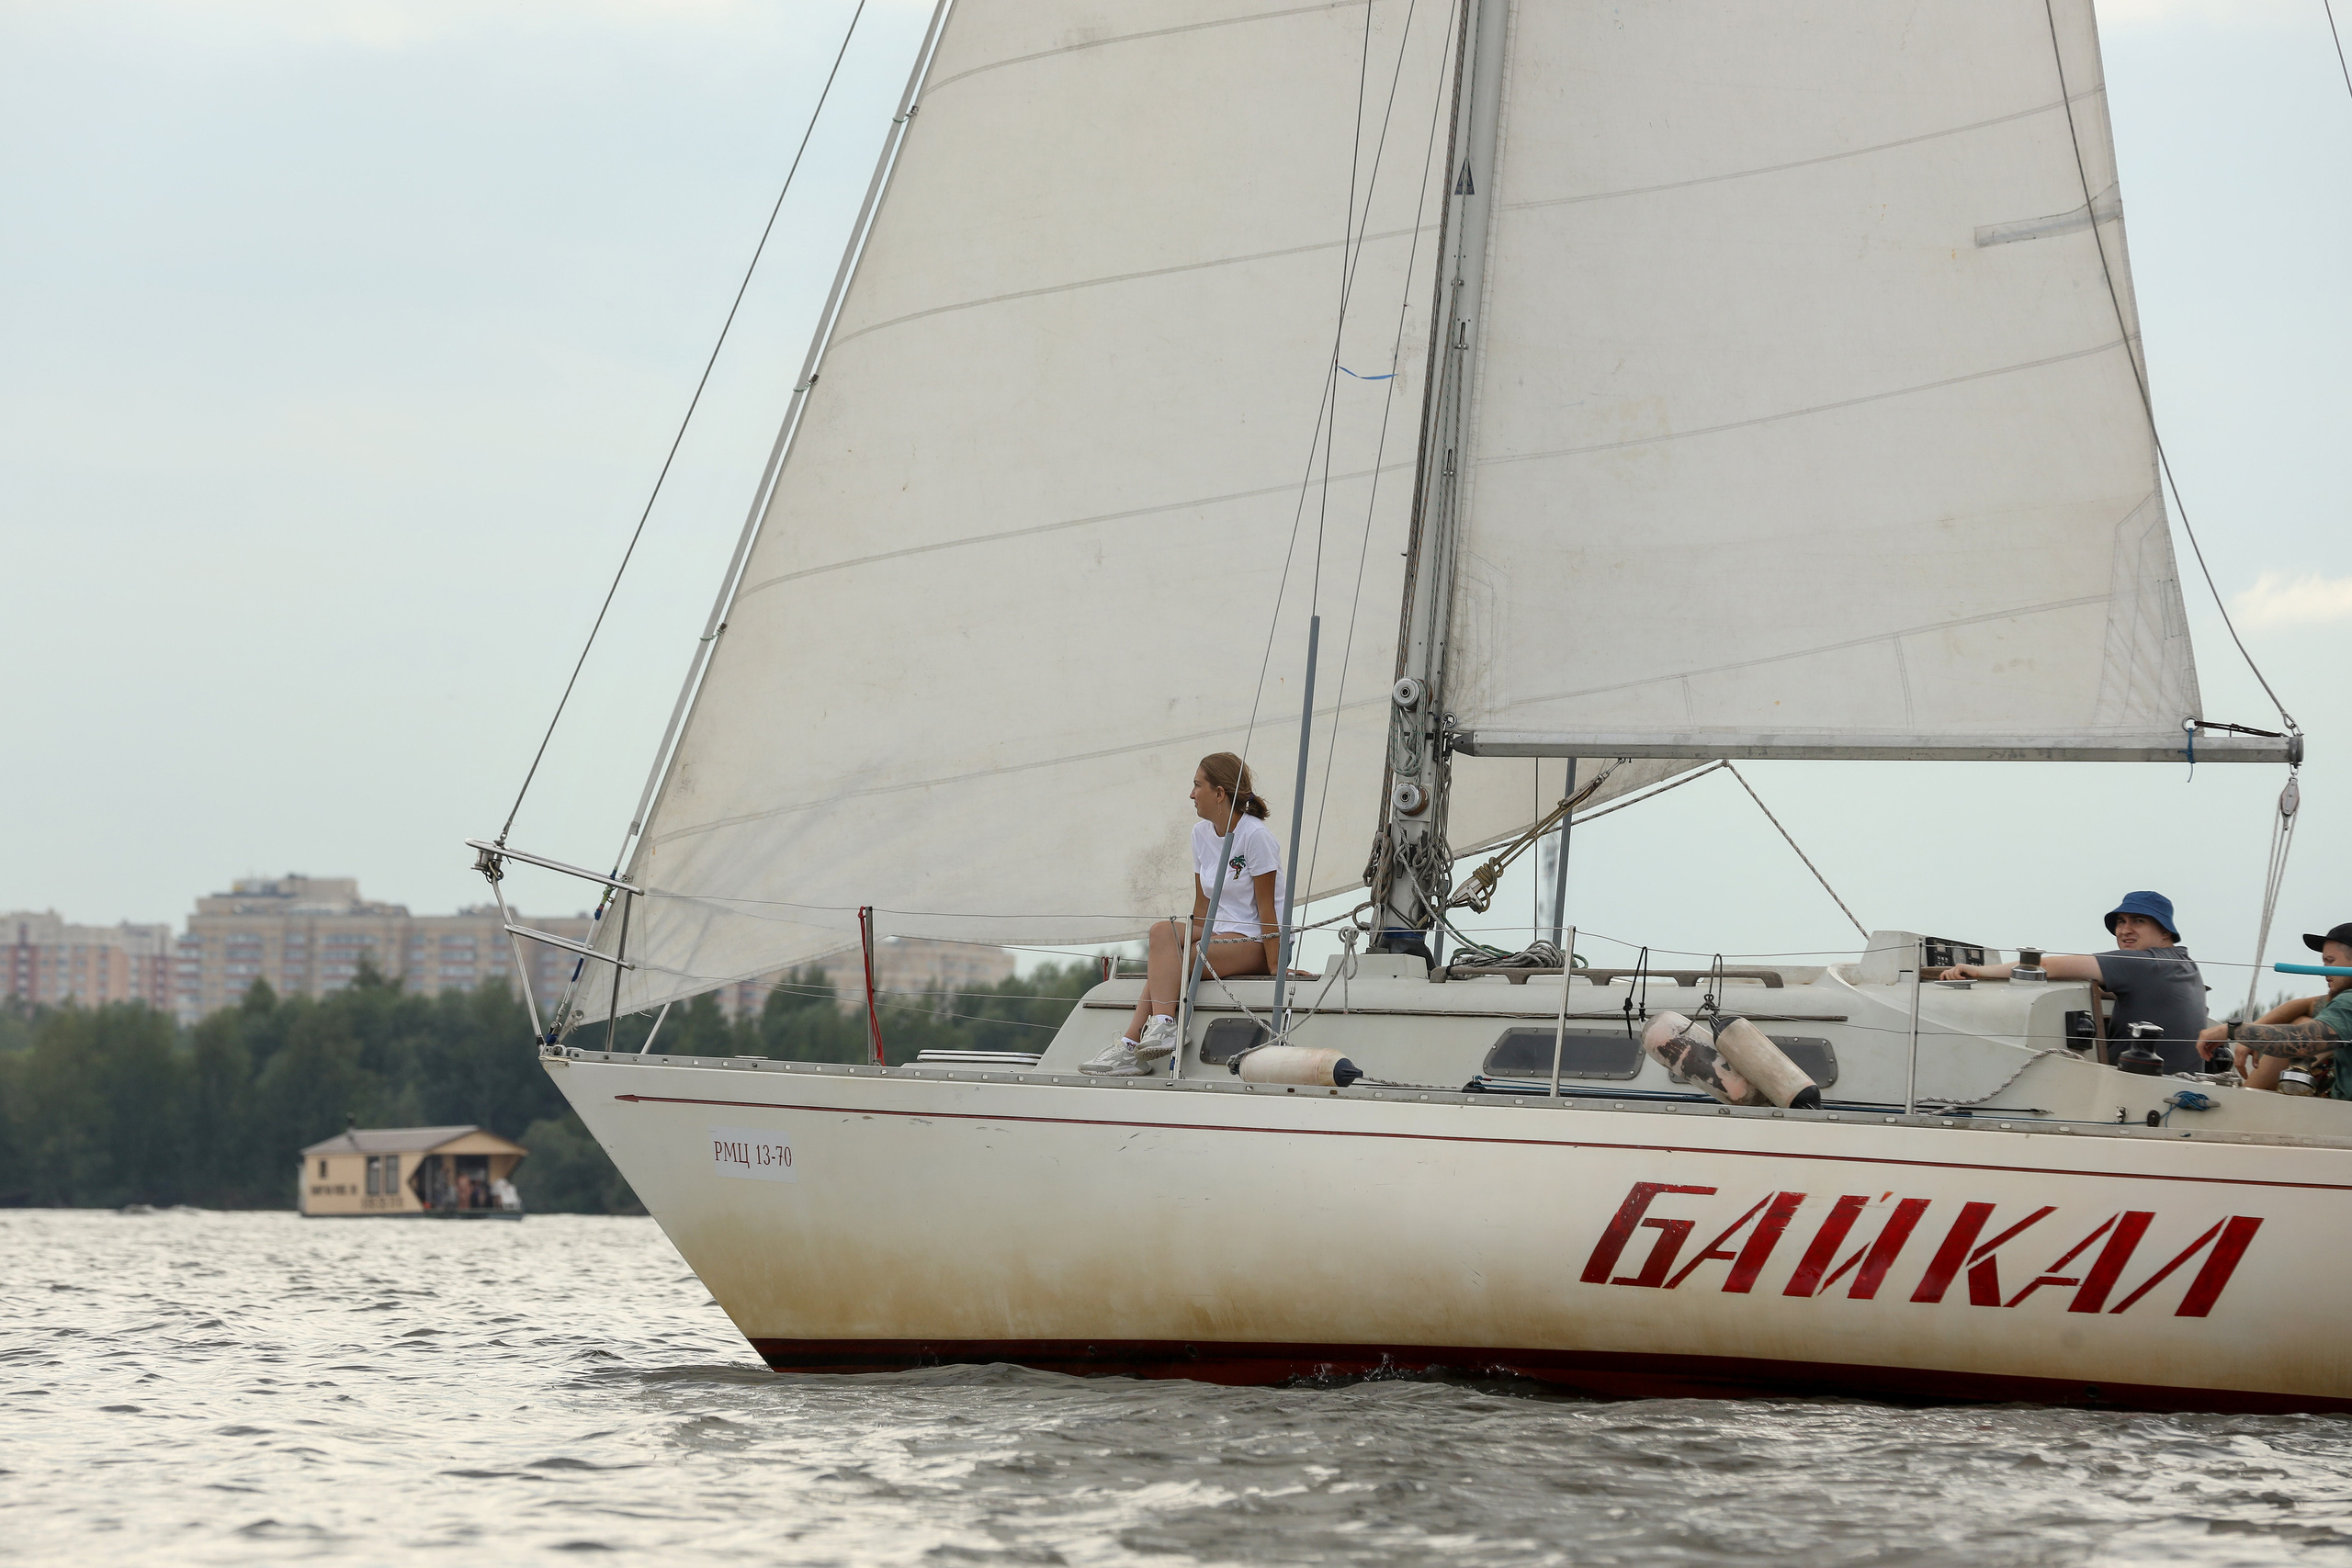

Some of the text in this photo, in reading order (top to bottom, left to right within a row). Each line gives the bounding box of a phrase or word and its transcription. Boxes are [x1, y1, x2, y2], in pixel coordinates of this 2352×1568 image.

[714, 1141, 792, 1168] РМЦ 13-70
[1579, 1181, 2265, 1317] БАЙКАЛ
